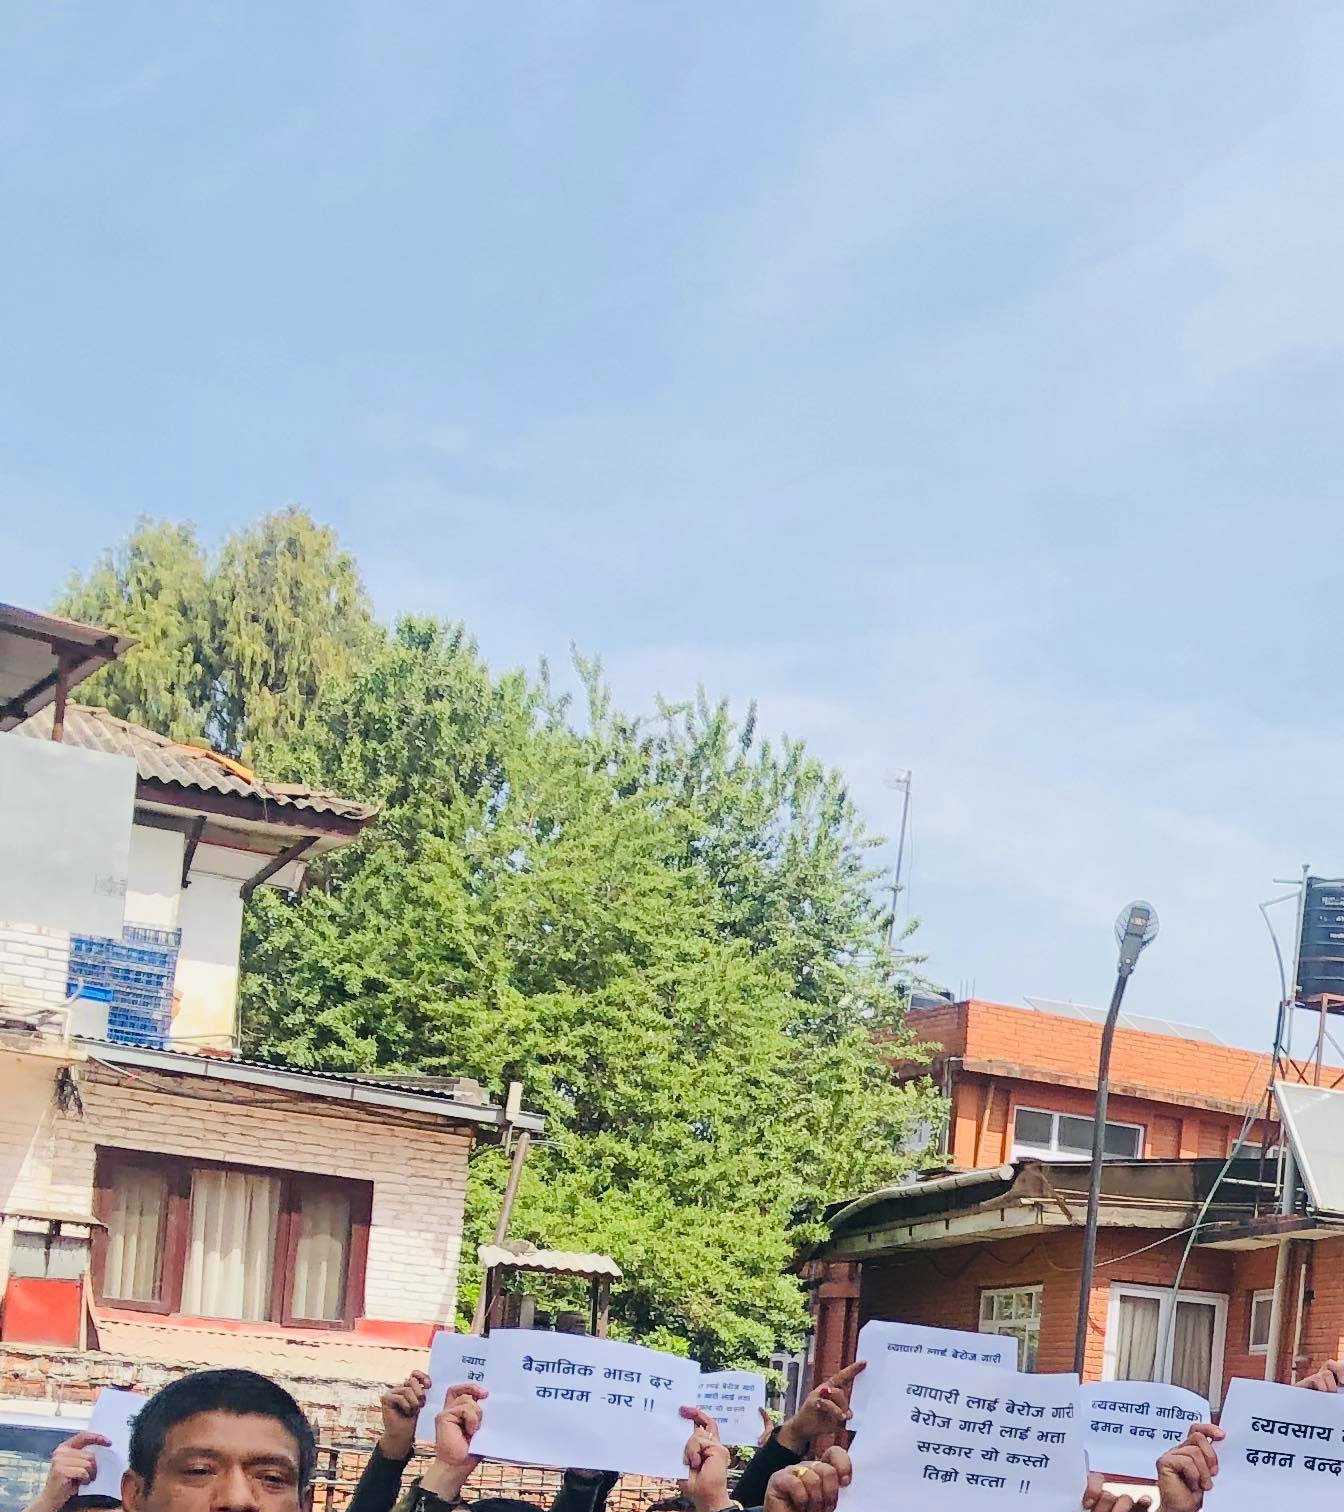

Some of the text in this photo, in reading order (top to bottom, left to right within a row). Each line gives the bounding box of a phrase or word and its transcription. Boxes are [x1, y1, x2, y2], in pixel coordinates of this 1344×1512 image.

[535, 1385, 591, 1404] कायम
[650, 1375, 674, 1391] दर
[1091, 1420, 1123, 1434] दमन
[1162, 1429, 1183, 1443] गर
[917, 1440, 974, 1459] सरकार
[1006, 1453, 1050, 1469] कस्तो
[1246, 1448, 1296, 1469] दमन
[1304, 1455, 1344, 1475] बन्द
